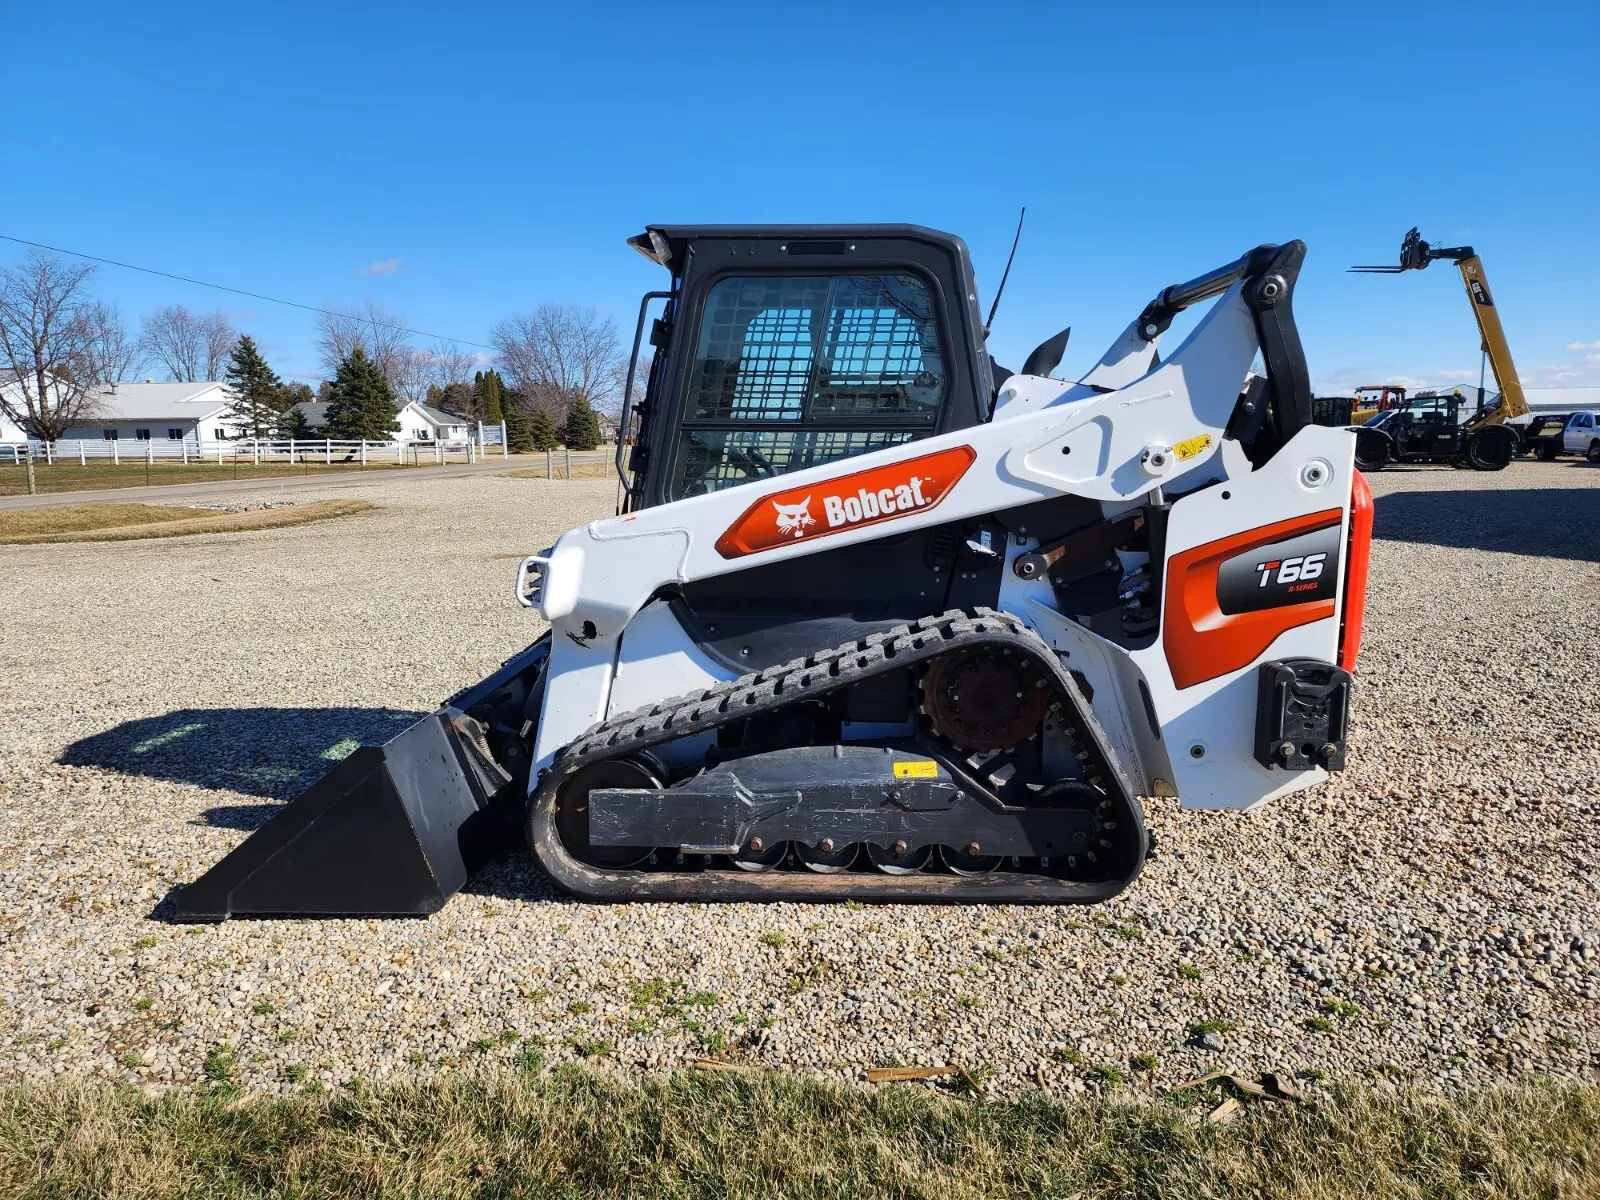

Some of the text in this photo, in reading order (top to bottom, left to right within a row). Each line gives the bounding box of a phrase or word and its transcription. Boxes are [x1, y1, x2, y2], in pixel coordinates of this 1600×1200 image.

[823, 476, 926, 528] Bobcat
[1257, 553, 1326, 587] T66
[1288, 582, 1318, 592] R-SERIES
